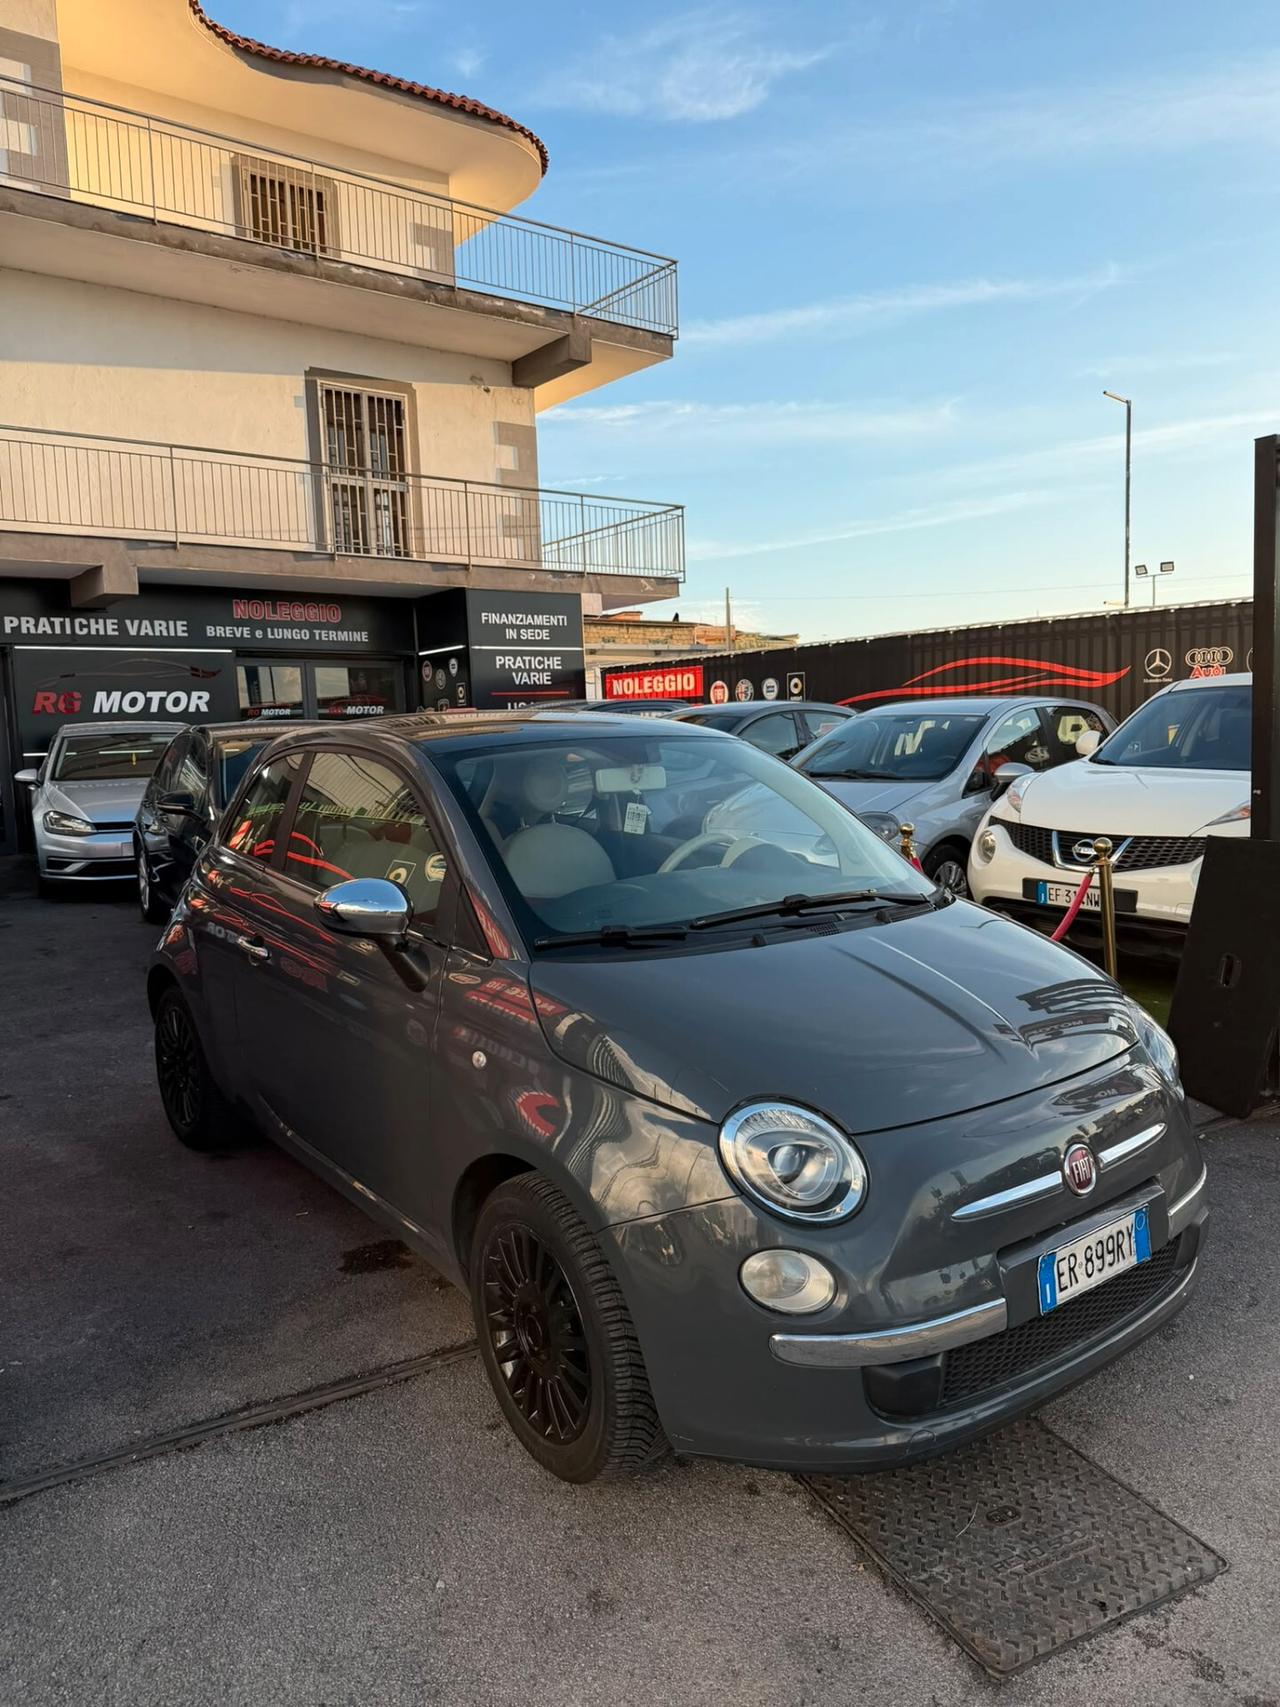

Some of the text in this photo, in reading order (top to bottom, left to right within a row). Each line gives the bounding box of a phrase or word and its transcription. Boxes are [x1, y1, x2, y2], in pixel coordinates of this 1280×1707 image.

[232, 599, 342, 623] NOLEGGIO
[481, 612, 568, 626] FINANZIAMENTI
[3, 616, 189, 637] PRATICHE VARIE
[206, 626, 369, 643] BREVE e LUNGO TERMINE
[505, 628, 551, 640] IN SEDE
[495, 656, 562, 670] PRATICHE
[512, 672, 552, 685] VARIE
[612, 673, 696, 696] NOLEGGIO
[32, 691, 210, 715] RG MOTOR
[346, 705, 384, 715] MOTOR
[260, 708, 291, 716] MOTOR
[1048, 887, 1062, 902] EF
[1072, 1157, 1092, 1183] FIAT
[1056, 1225, 1134, 1293] ER 899RY
